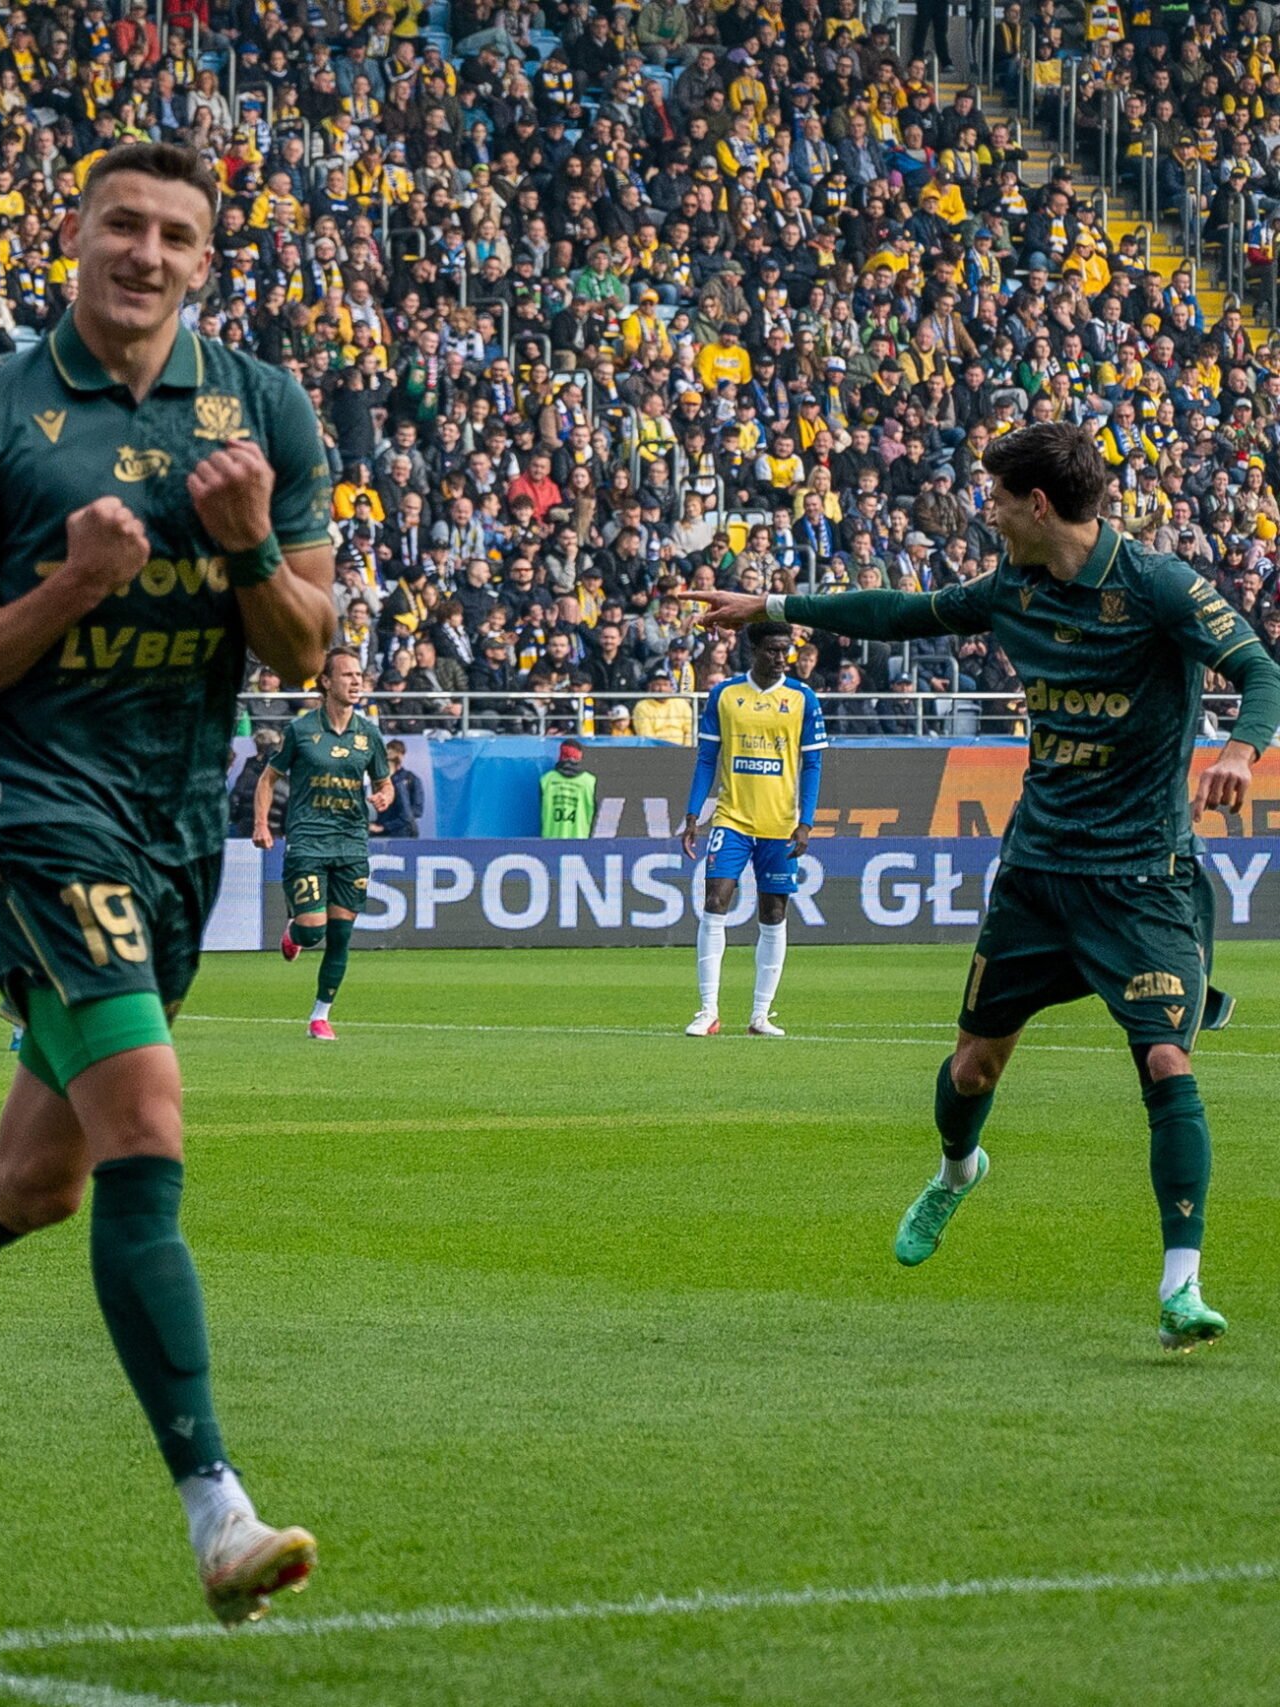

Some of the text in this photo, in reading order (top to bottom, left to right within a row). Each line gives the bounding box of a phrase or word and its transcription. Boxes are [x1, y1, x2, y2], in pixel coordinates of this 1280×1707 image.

[1026, 677, 1131, 718] drovo
[734, 756, 782, 775] maspo
[1031, 732, 1116, 767] VBET
[293, 875, 320, 905] 21
[60, 881, 148, 967] 19
